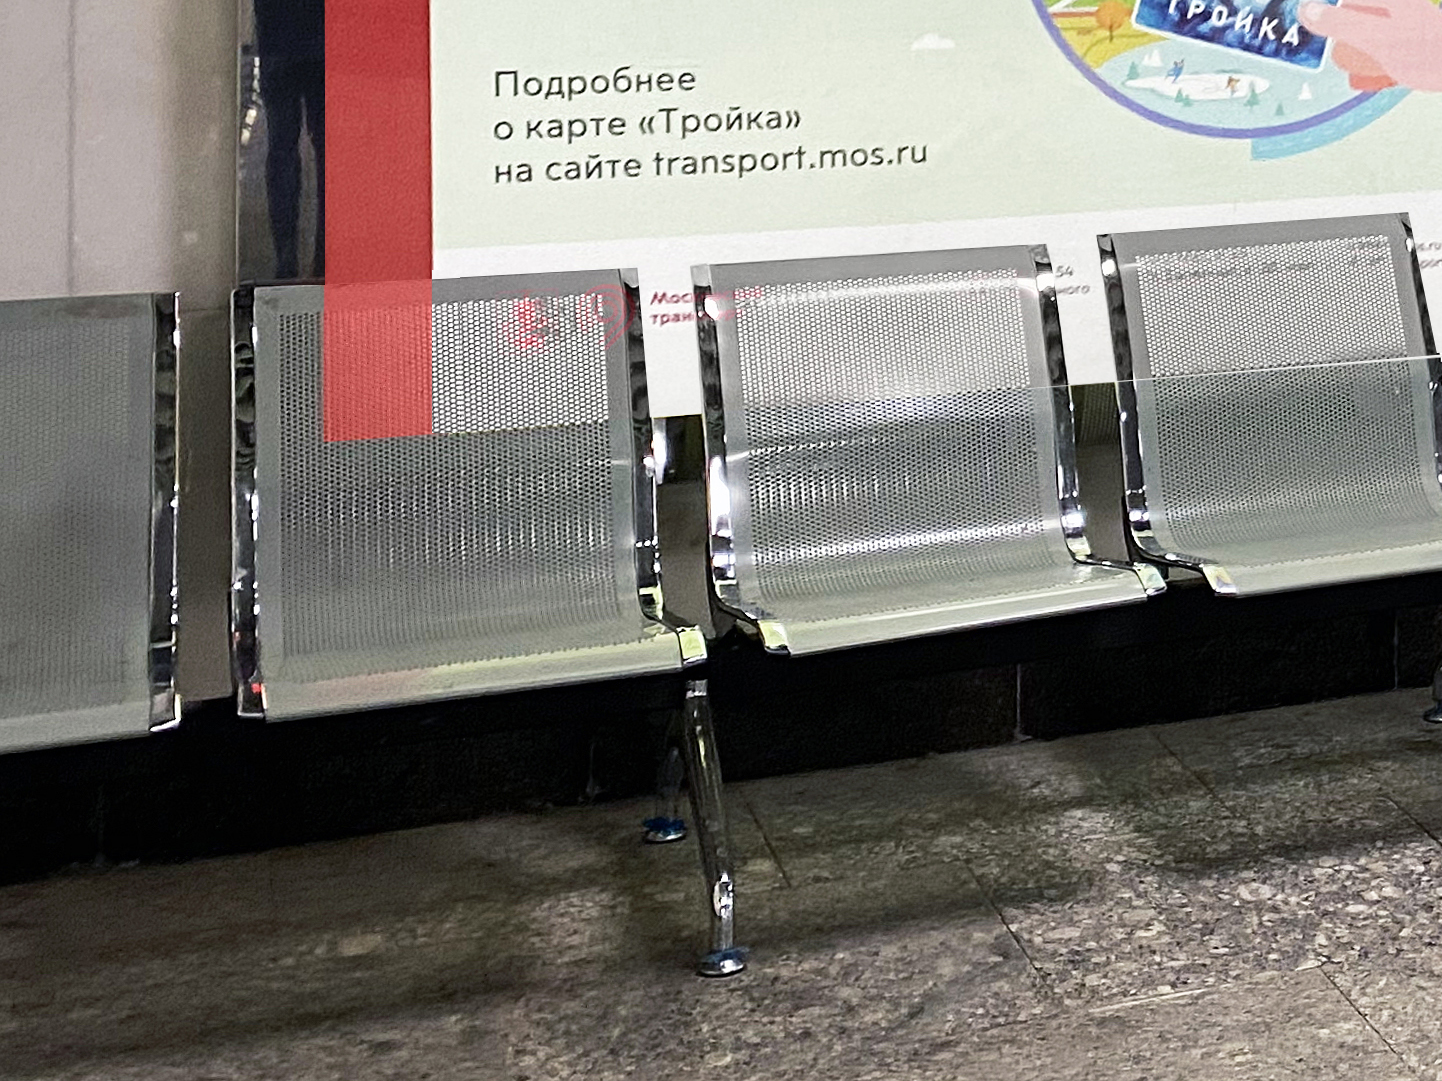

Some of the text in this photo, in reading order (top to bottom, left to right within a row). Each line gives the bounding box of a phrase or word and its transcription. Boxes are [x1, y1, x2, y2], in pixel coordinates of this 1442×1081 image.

[495, 65, 696, 102] Подробнее
[493, 106, 801, 145] о карте «Тройка»
[495, 145, 927, 184] на сайте transport.mos.ru
